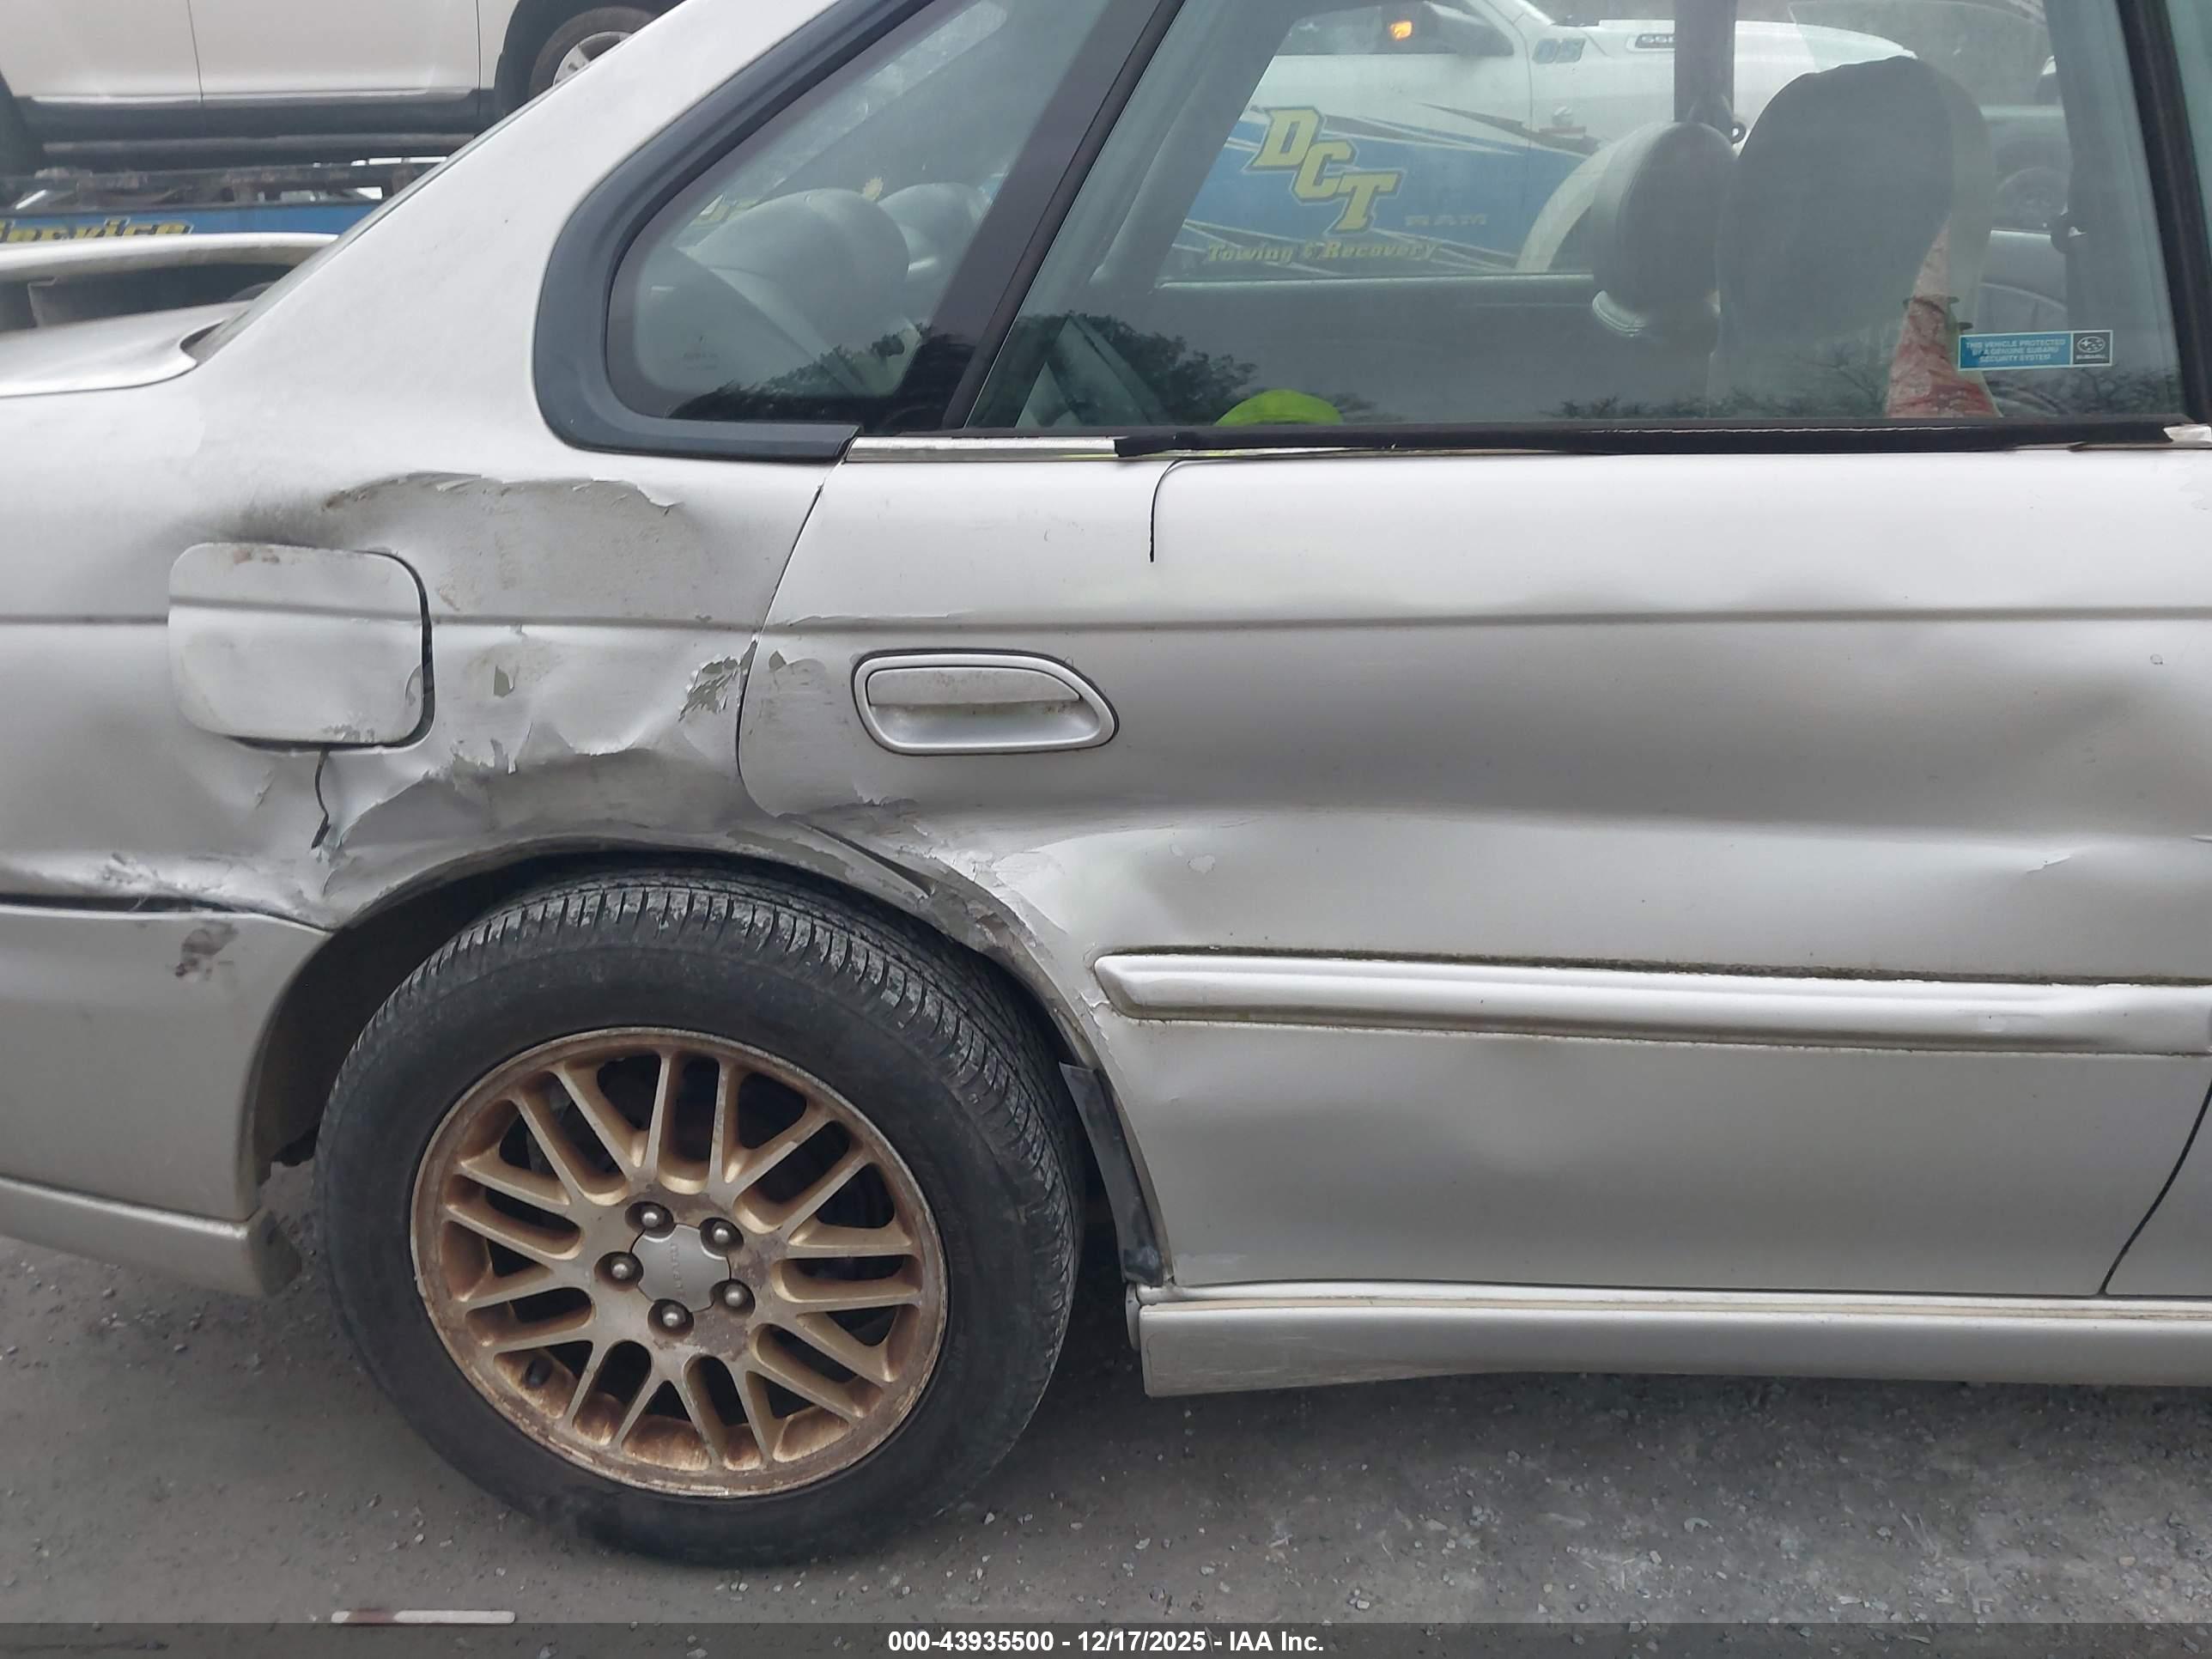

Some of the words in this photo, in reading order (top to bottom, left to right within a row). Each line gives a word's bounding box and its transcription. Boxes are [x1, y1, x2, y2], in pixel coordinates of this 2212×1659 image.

[1249, 106, 1401, 233] DCT
[1206, 243, 1292, 263] Towing
[1320, 240, 1437, 260] Recovery
[2019, 338, 2066, 347] PROTECTED
[1978, 354, 2019, 363] SECURITY
